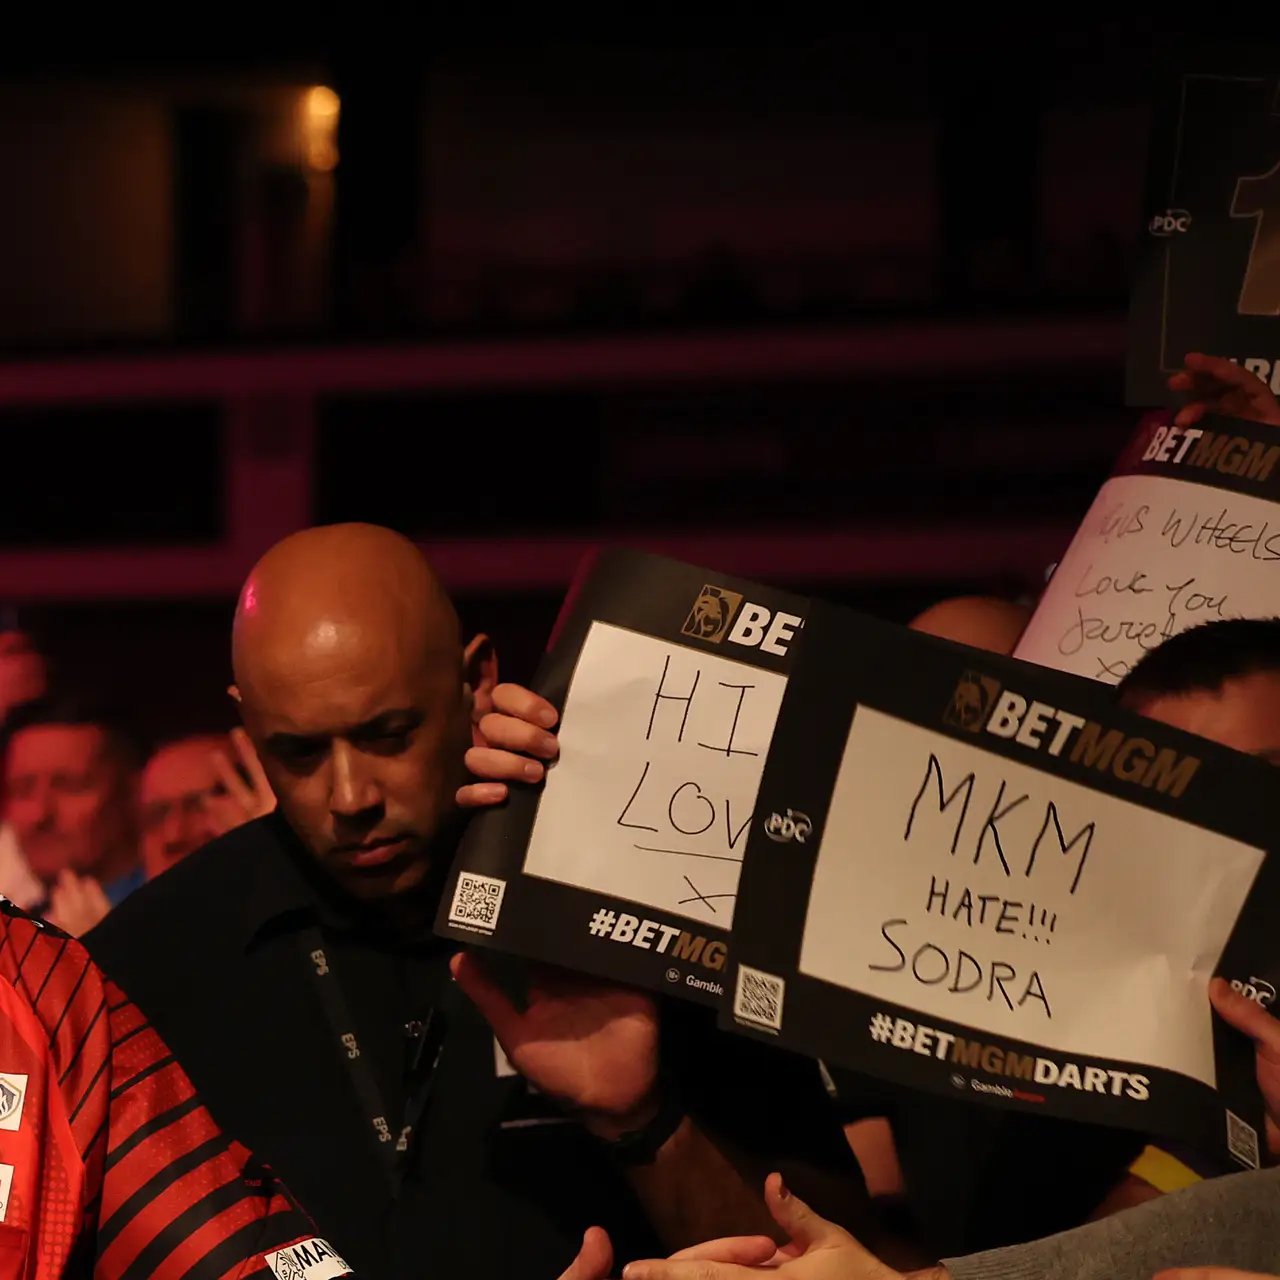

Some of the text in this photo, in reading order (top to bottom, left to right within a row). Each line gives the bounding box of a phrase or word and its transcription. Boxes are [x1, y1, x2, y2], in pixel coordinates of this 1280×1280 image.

[728, 602, 806, 657] BE
[646, 655, 758, 757] HI
[986, 689, 1202, 798] BETMGM
[904, 753, 1095, 895] MKM
[589, 908, 727, 972] #BETMG
[926, 876, 1057, 945] HATE!!!
[868, 919, 1051, 1018] SODRA
[868, 1013, 1150, 1101] #BETMGMDARTS
